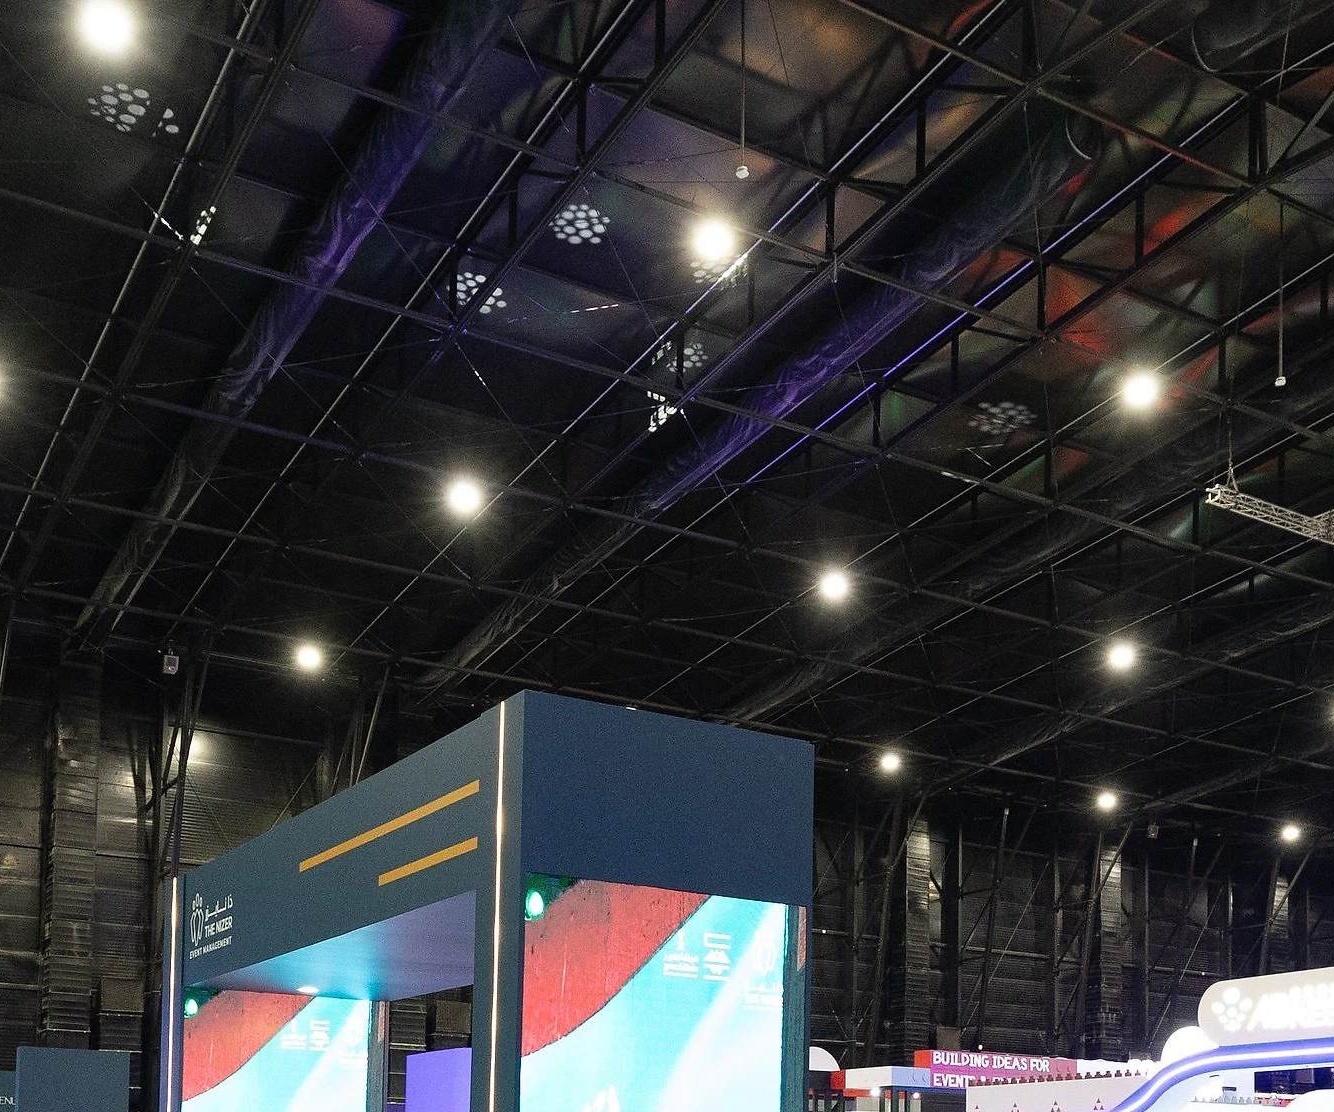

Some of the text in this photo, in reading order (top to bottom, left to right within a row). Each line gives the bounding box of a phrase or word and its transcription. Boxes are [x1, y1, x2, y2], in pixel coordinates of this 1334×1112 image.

[204, 915, 233, 938] THE NIZER
[189, 935, 233, 960] EVENT MANAGEMENT
[932, 1051, 1051, 1073] BUILDING IDEAS FOR
